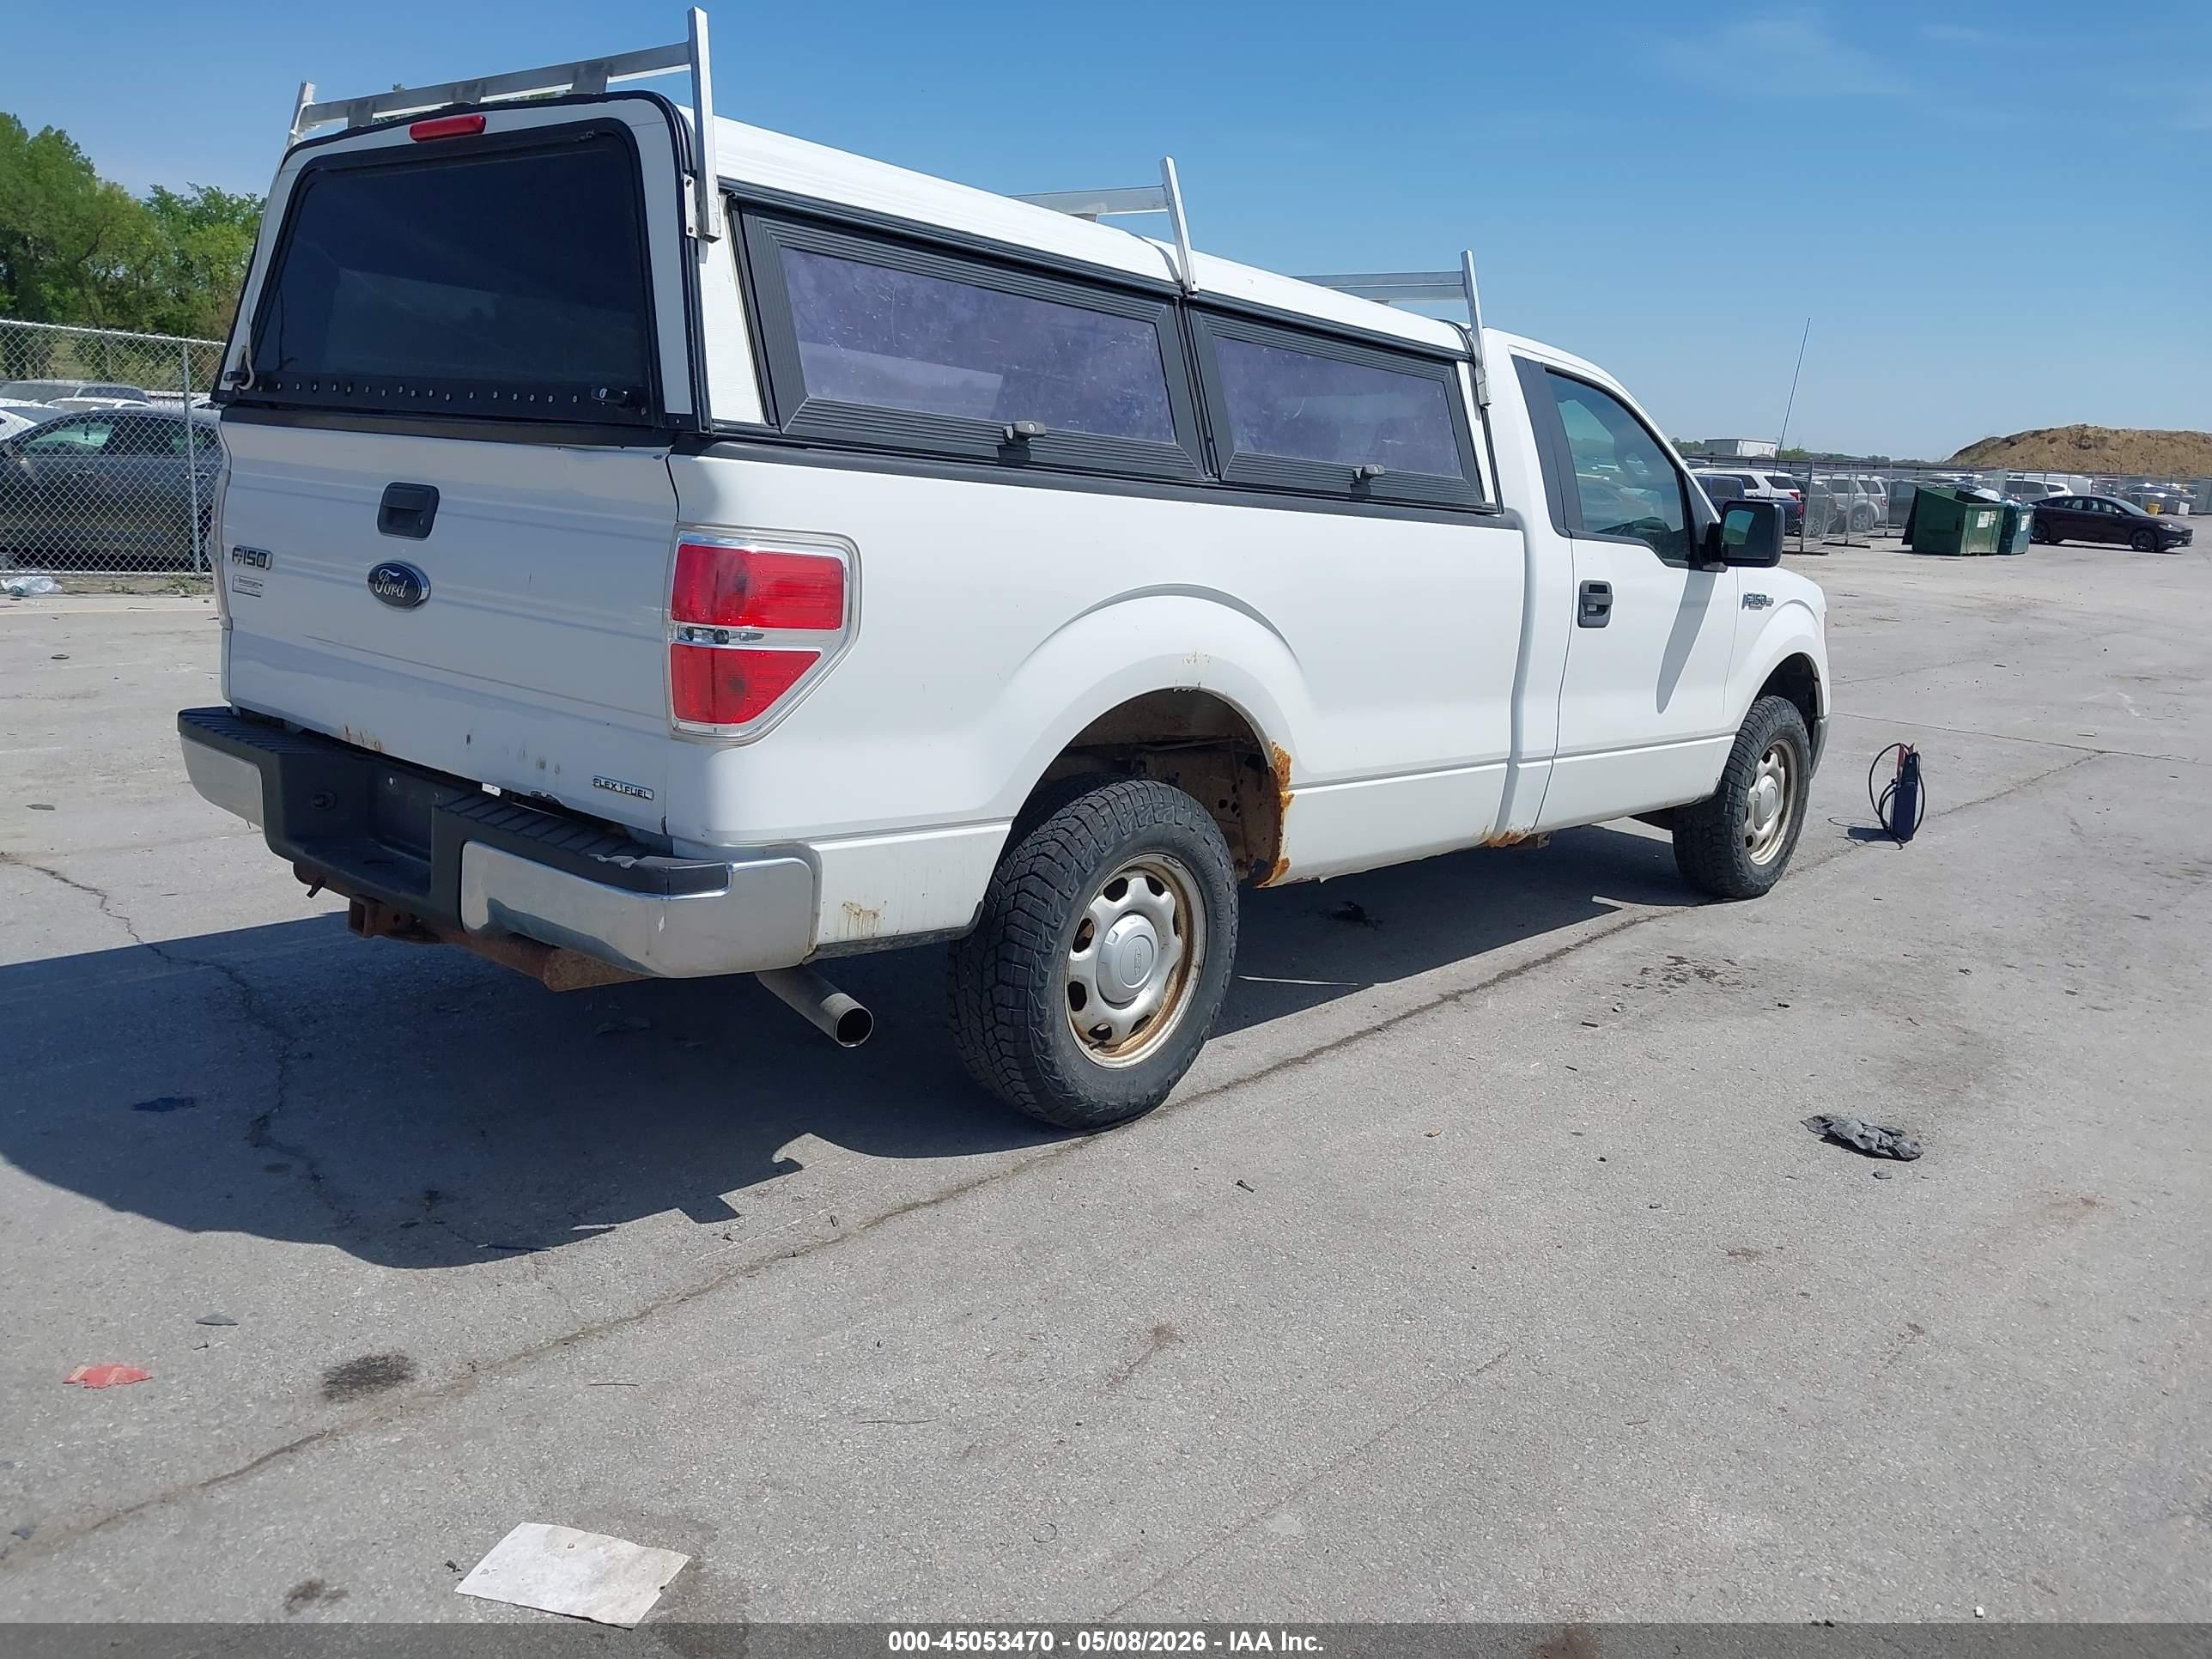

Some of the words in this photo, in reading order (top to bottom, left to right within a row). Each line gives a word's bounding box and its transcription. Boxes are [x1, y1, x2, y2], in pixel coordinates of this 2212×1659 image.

[375, 568, 408, 599] Ford
[592, 777, 618, 791] FLEX
[624, 786, 652, 799] FUEL
